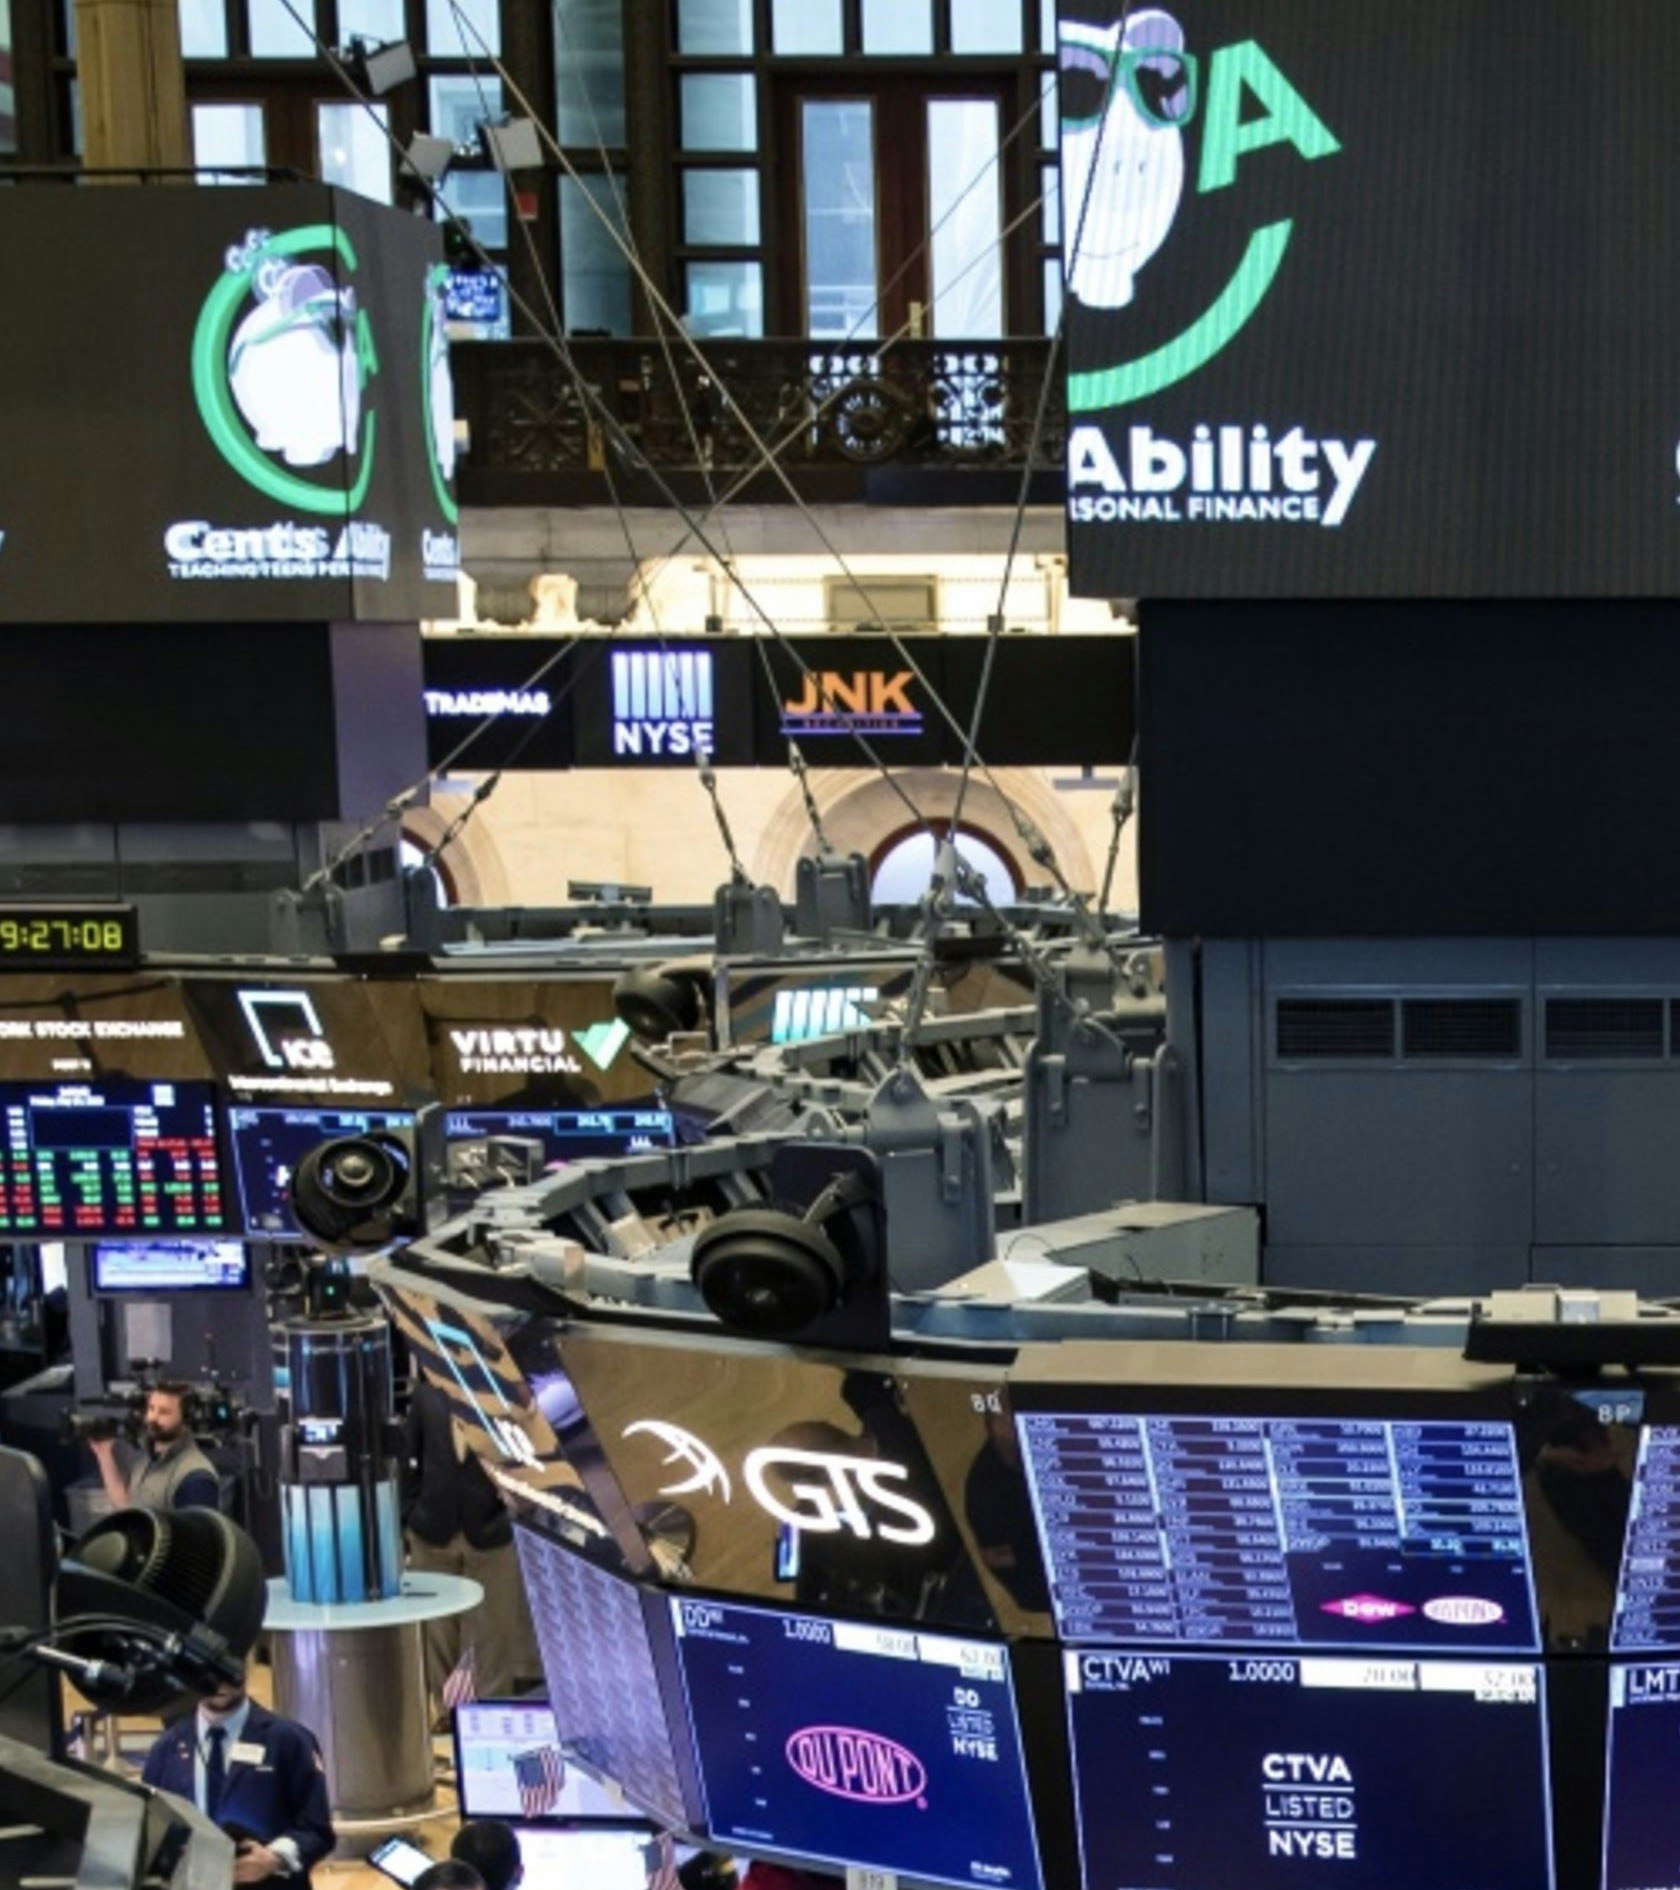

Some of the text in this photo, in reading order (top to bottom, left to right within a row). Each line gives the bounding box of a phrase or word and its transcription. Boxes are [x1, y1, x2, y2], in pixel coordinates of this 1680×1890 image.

[1068, 424, 1375, 525] Ability
[1188, 495, 1319, 521] FINANCE
[164, 521, 330, 561] Cents
[784, 670, 922, 714] JNK
[614, 722, 714, 754] NYSE
[0, 920, 123, 951] 9:27:08
[35, 1021, 91, 1040] STOCK
[94, 1020, 185, 1040] EXCHANGE
[451, 1030, 567, 1057] VIRTU
[281, 1039, 335, 1069] ICE
[461, 1056, 581, 1075] FINANCIAL
[744, 1446, 936, 1545] GTS
[1229, 1663, 1295, 1683] 1.0000
[952, 1737, 999, 1762] NYSE
[1262, 1754, 1352, 1784] CTVA
[1265, 1796, 1354, 1820] LISTED
[1268, 1831, 1357, 1860] NYSE
